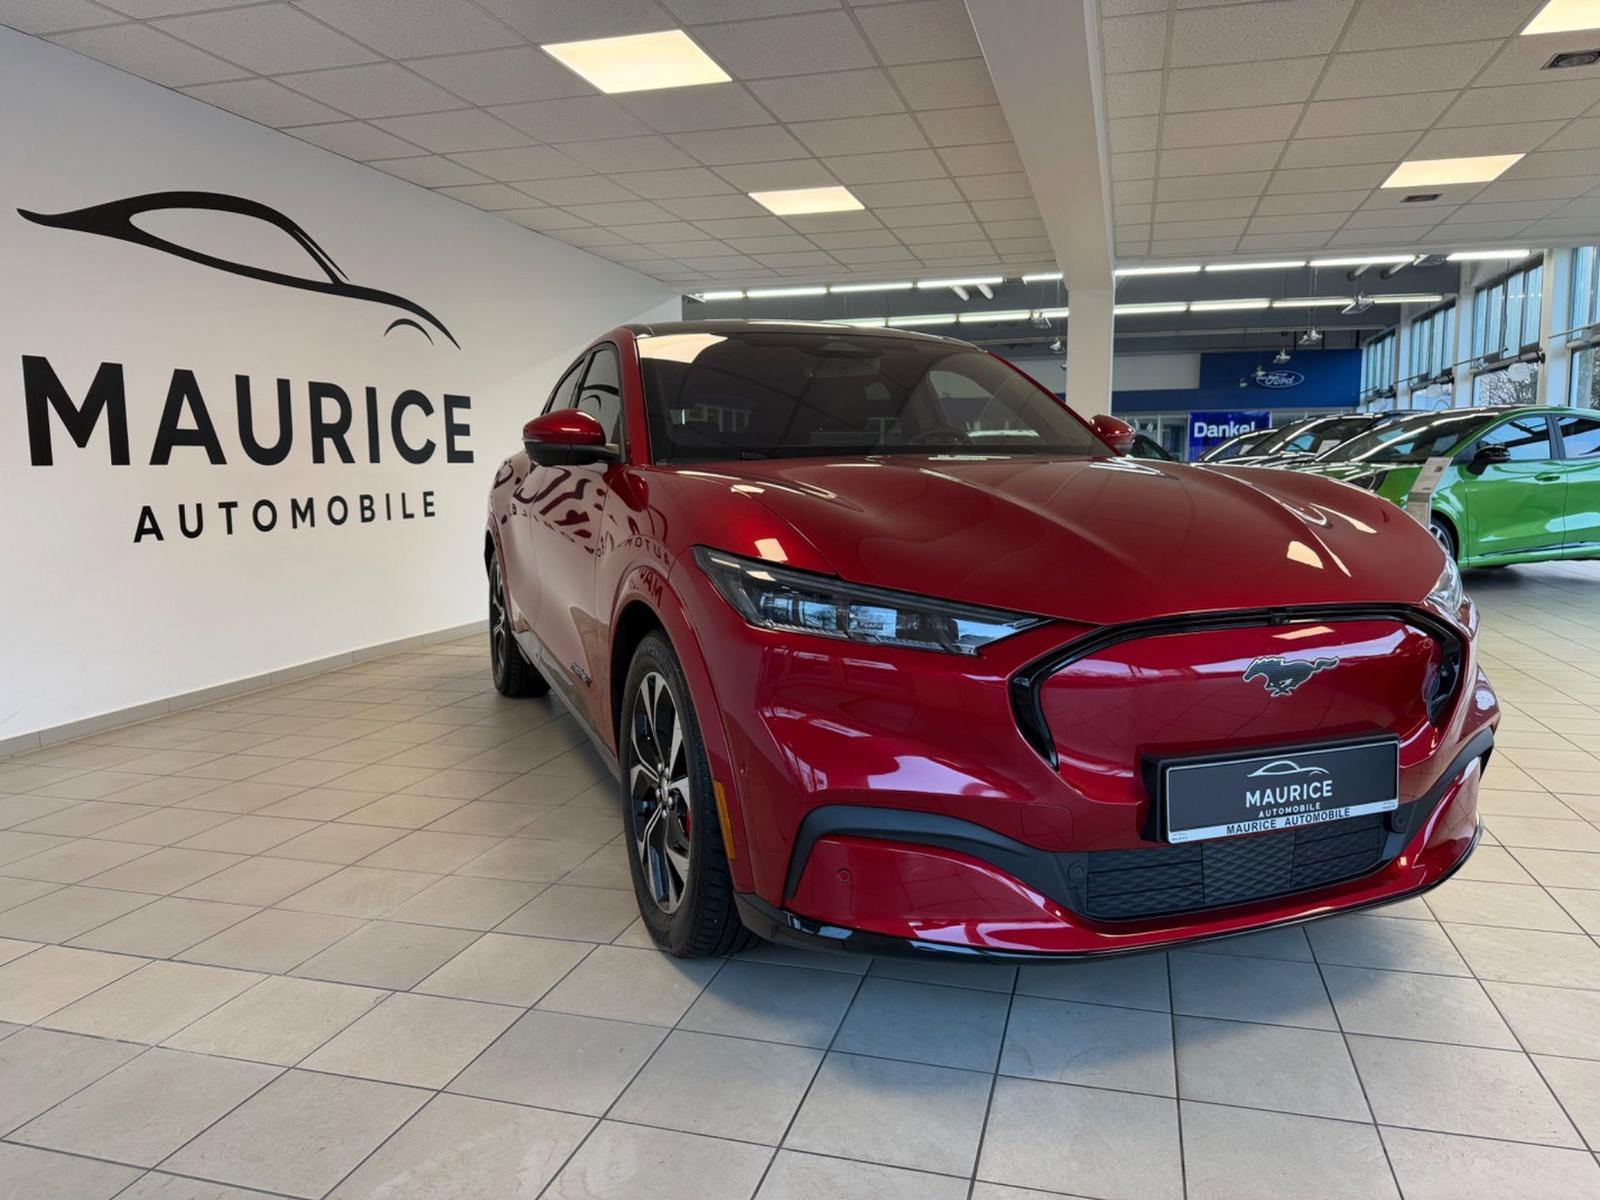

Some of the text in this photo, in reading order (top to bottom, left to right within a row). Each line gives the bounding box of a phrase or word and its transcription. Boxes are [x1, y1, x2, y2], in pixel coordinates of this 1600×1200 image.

[1264, 372, 1296, 385] Ford
[21, 354, 475, 467] MAURICE
[133, 490, 437, 544] AUTOMOBILE
[1245, 779, 1334, 809] MAURICE
[1226, 807, 1351, 836] MAURICE AUTOMOBILE
[1258, 801, 1322, 819] AUTOMOBILE
